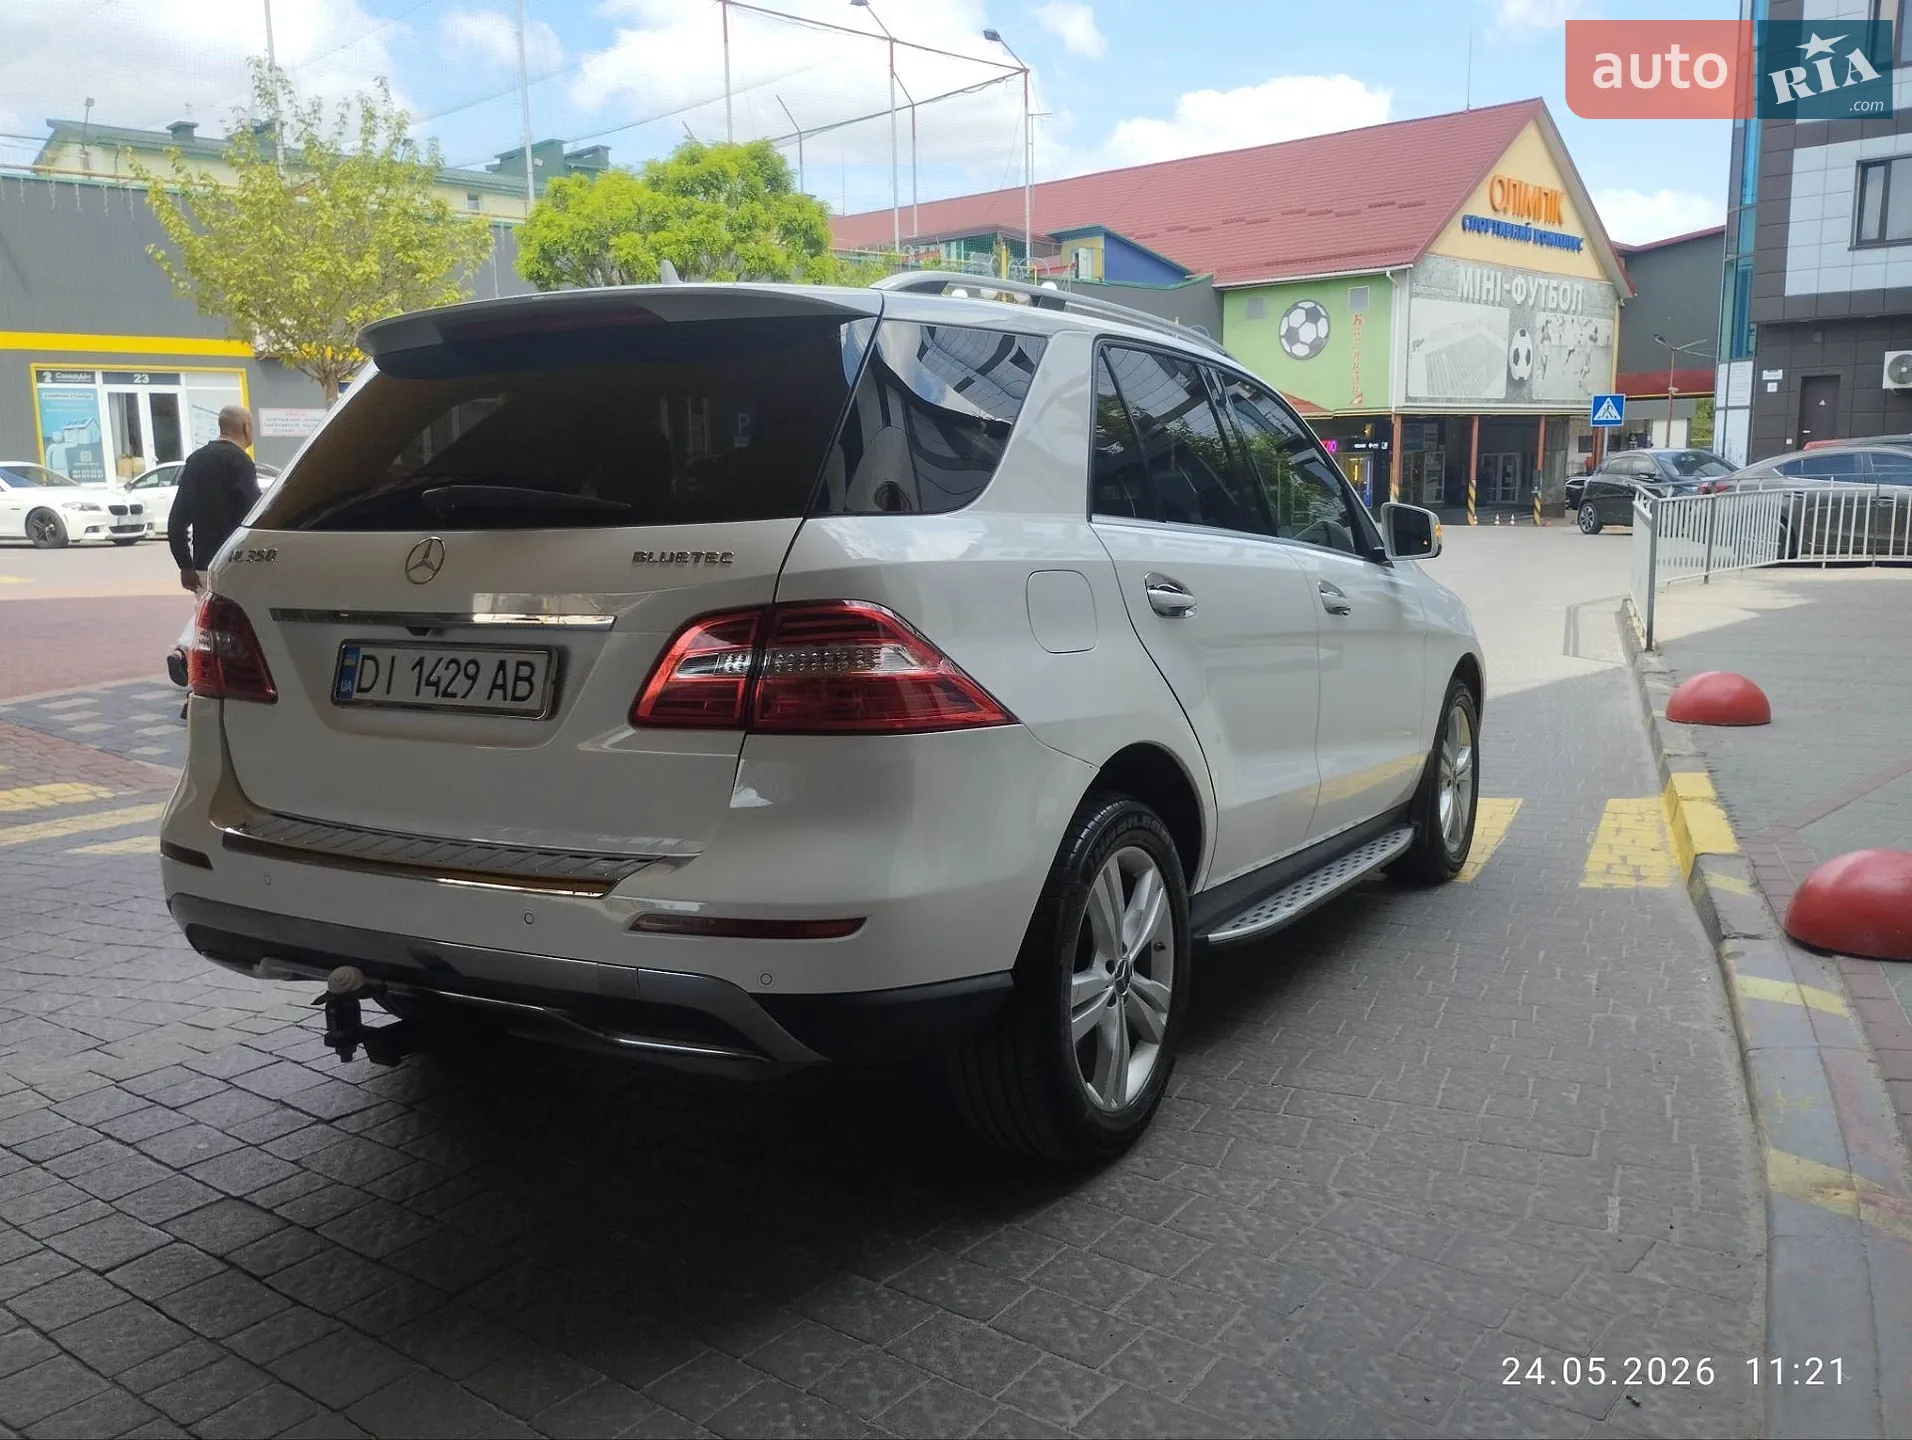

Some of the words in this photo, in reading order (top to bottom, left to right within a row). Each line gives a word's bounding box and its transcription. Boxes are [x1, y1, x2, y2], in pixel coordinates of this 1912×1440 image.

[1458, 266, 1585, 316] МІНІ-ФУТБОЛ
[133, 373, 150, 384] 23
[632, 550, 735, 565] BLUETEC
[356, 654, 396, 695] DI
[410, 656, 481, 699] 1429
[487, 659, 536, 702] AB
[341, 679, 354, 693] UA
